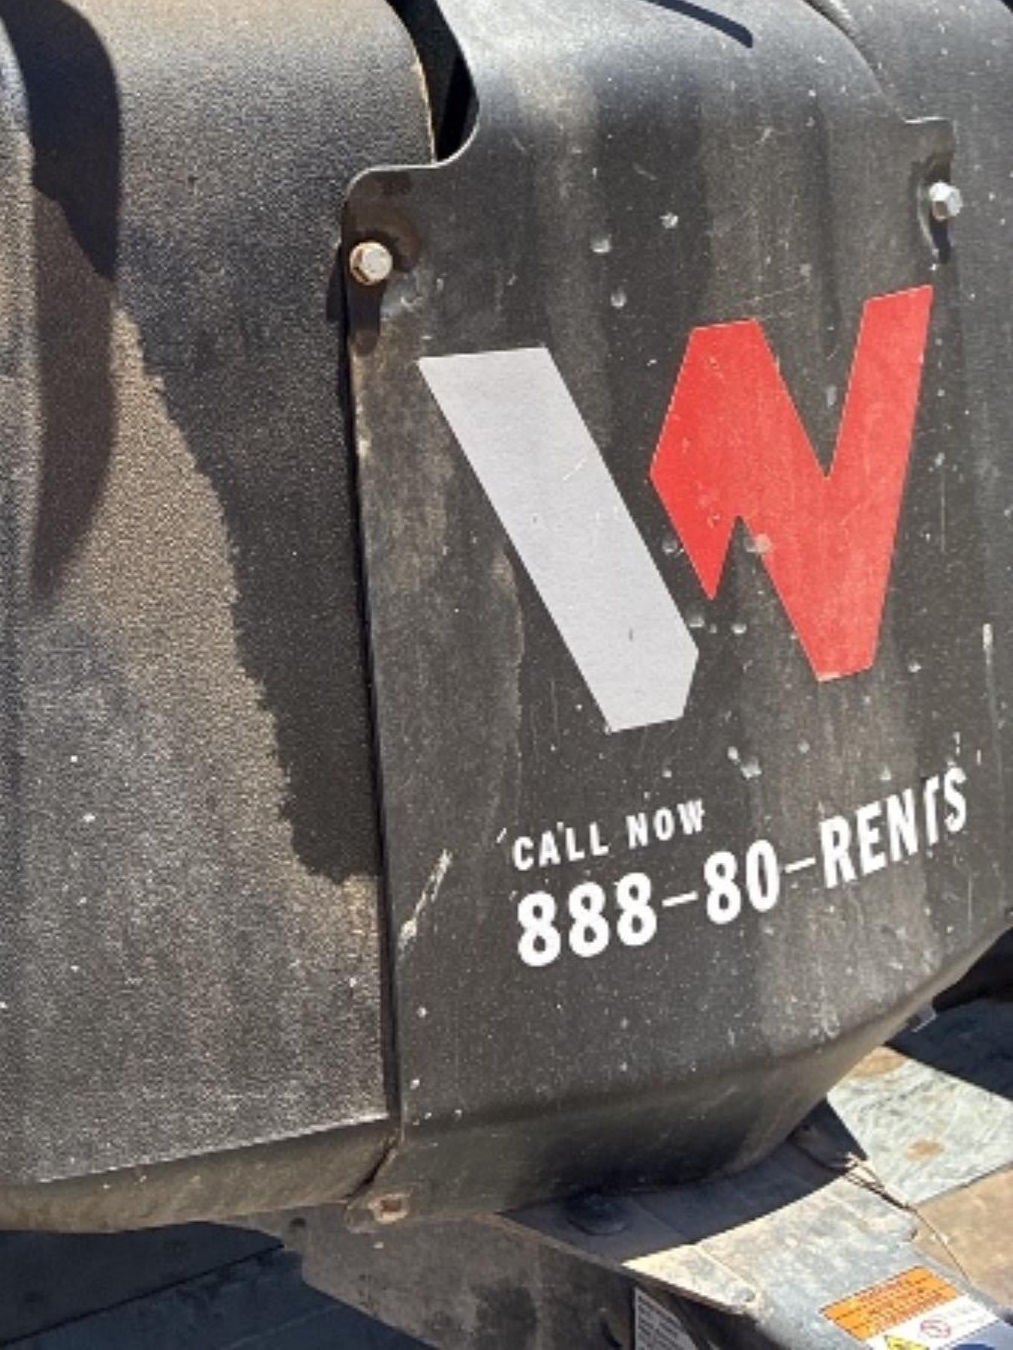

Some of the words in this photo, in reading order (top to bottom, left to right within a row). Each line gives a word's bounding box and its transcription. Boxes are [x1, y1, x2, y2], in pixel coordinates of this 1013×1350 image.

[512, 823, 609, 871] CALL
[626, 799, 705, 849] NOW
[517, 766, 967, 967] 888-80-RENTS
